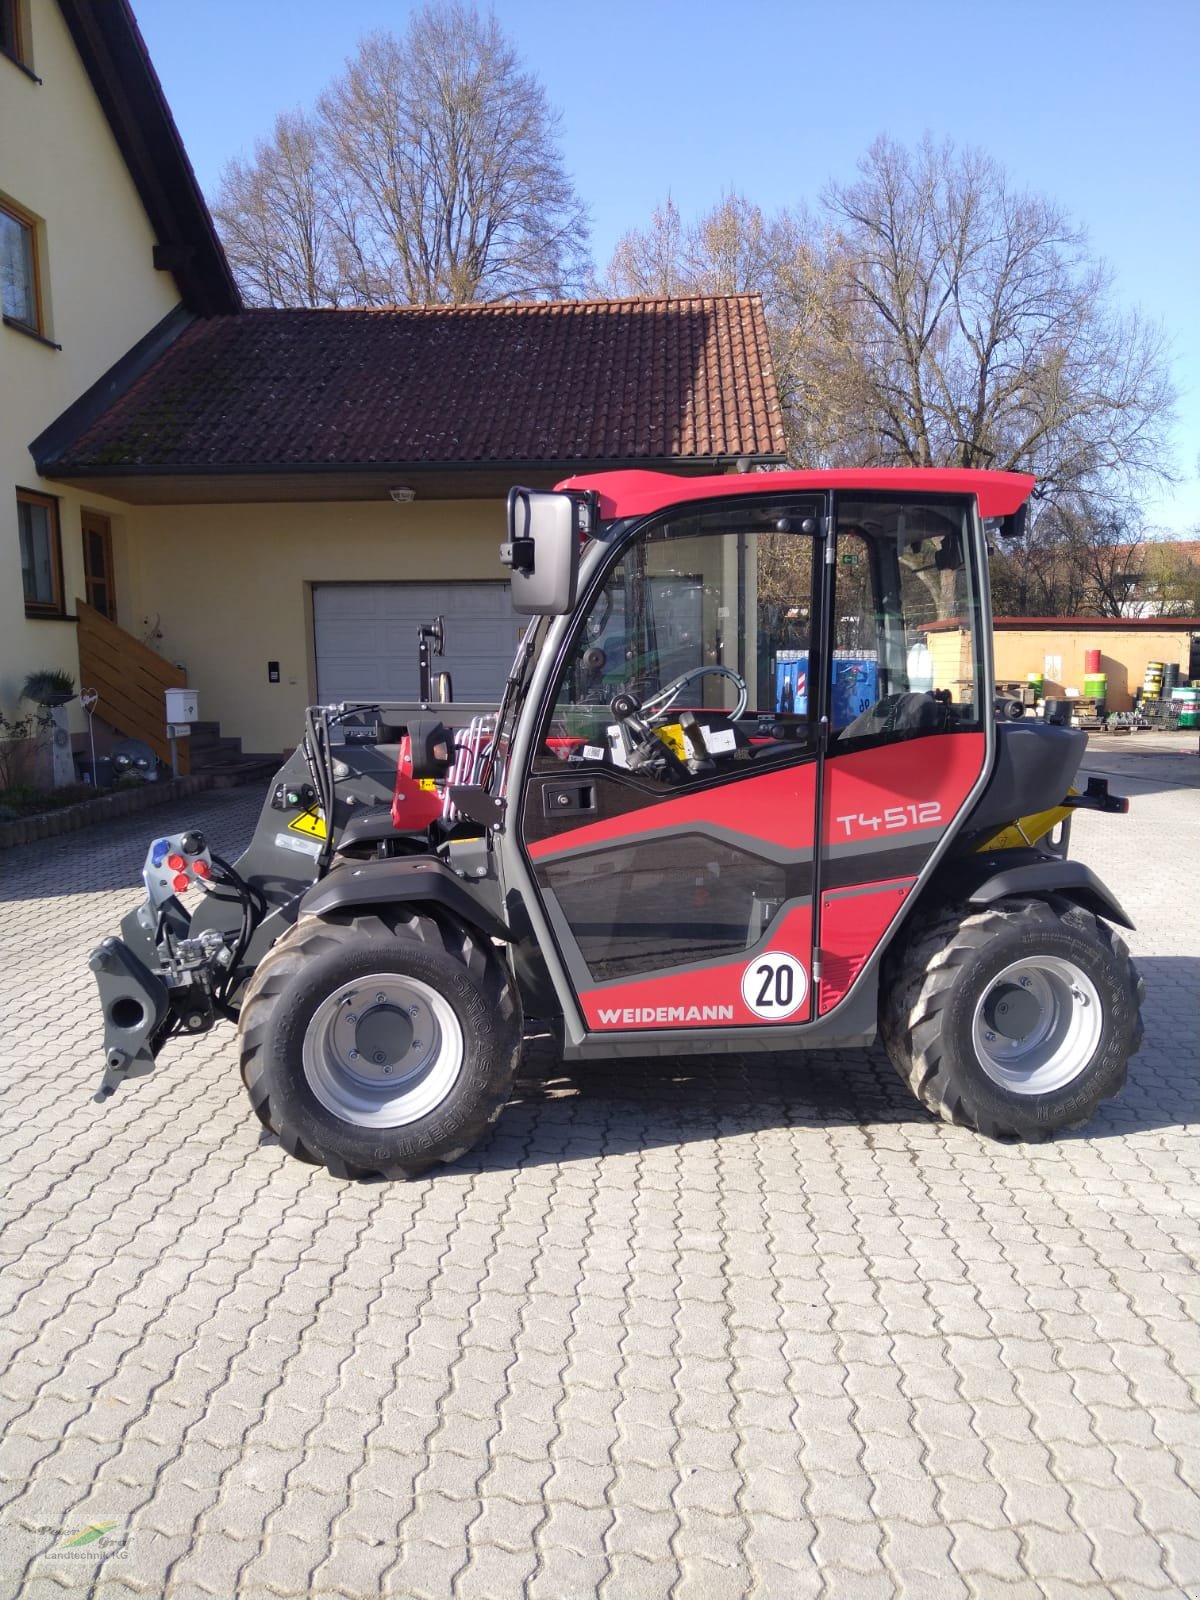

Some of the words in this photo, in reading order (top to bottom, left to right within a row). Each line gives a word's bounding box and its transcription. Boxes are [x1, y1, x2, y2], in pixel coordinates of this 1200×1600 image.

[836, 801, 942, 836] T4512
[755, 964, 794, 1007] 20
[597, 1004, 734, 1024] WEIDEMANN
